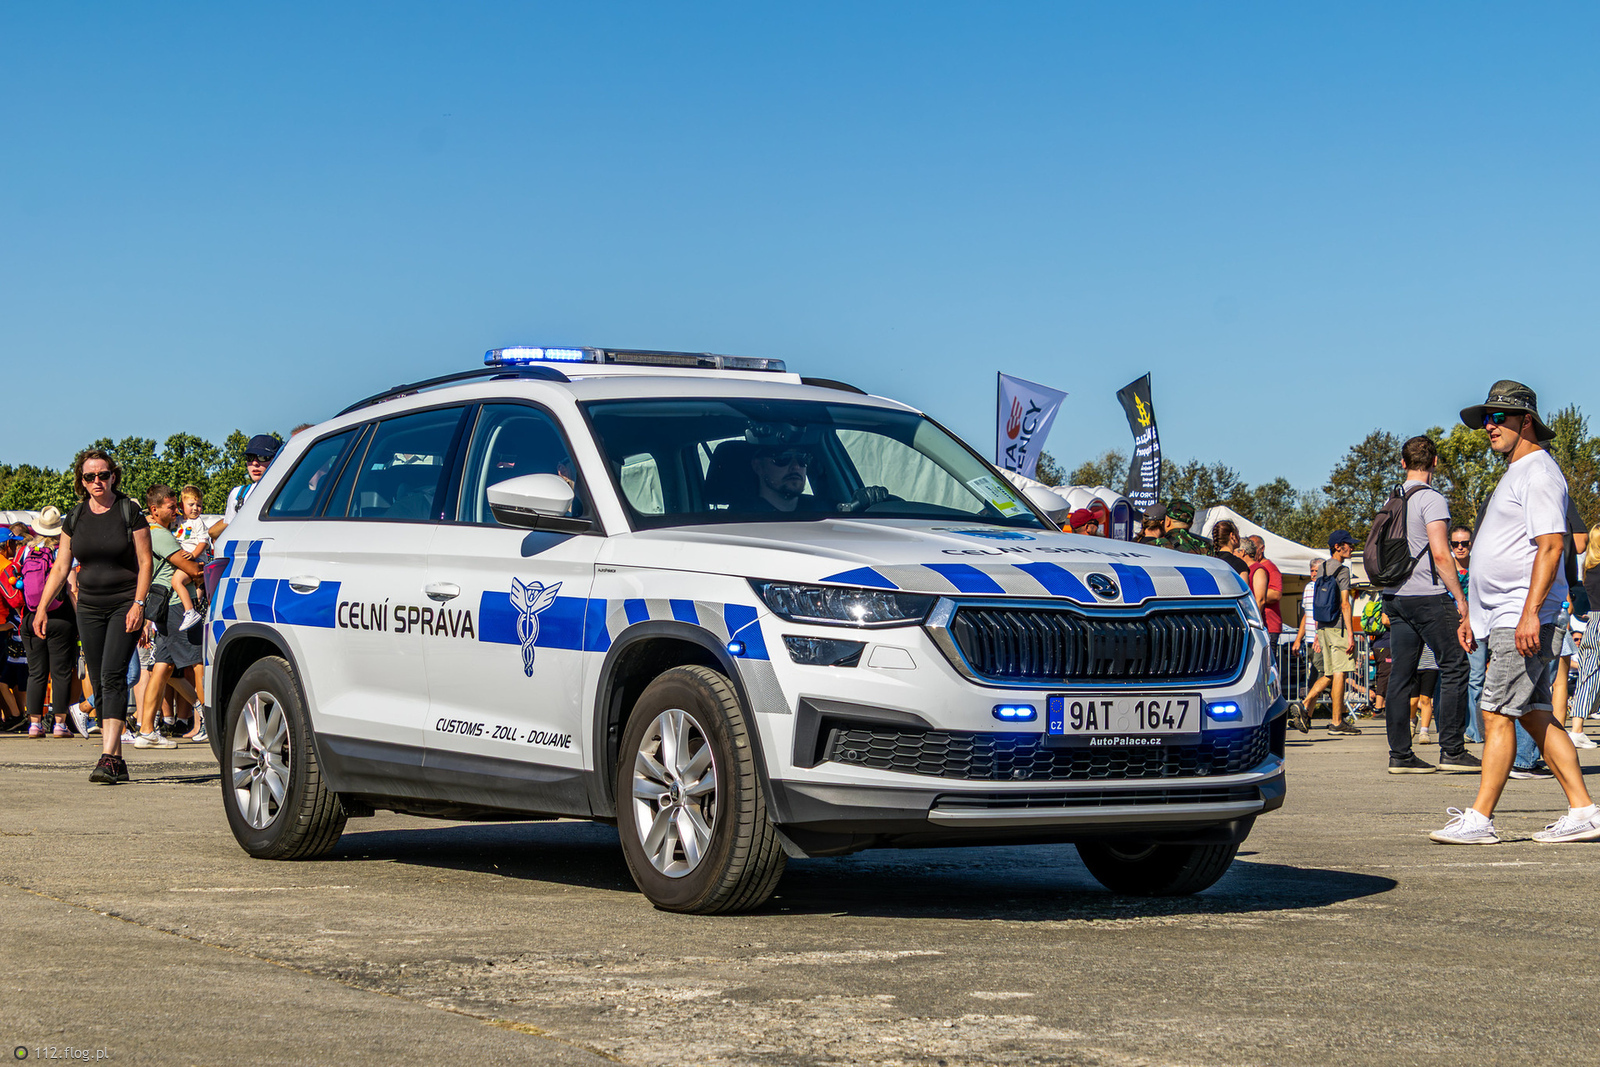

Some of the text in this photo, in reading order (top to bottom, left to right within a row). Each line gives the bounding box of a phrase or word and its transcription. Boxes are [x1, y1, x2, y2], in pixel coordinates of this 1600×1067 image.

[1016, 399, 1042, 475] ENCY
[338, 598, 475, 639] CELNÍ SPRÁVA
[1050, 721, 1062, 730] CZ
[1070, 700, 1190, 731] 9AT 1647
[435, 718, 484, 737] CUSTOMS
[491, 725, 517, 741] ZOLL
[527, 730, 572, 749] DOUANE
[1089, 736, 1162, 746] AutoPalace.cz
